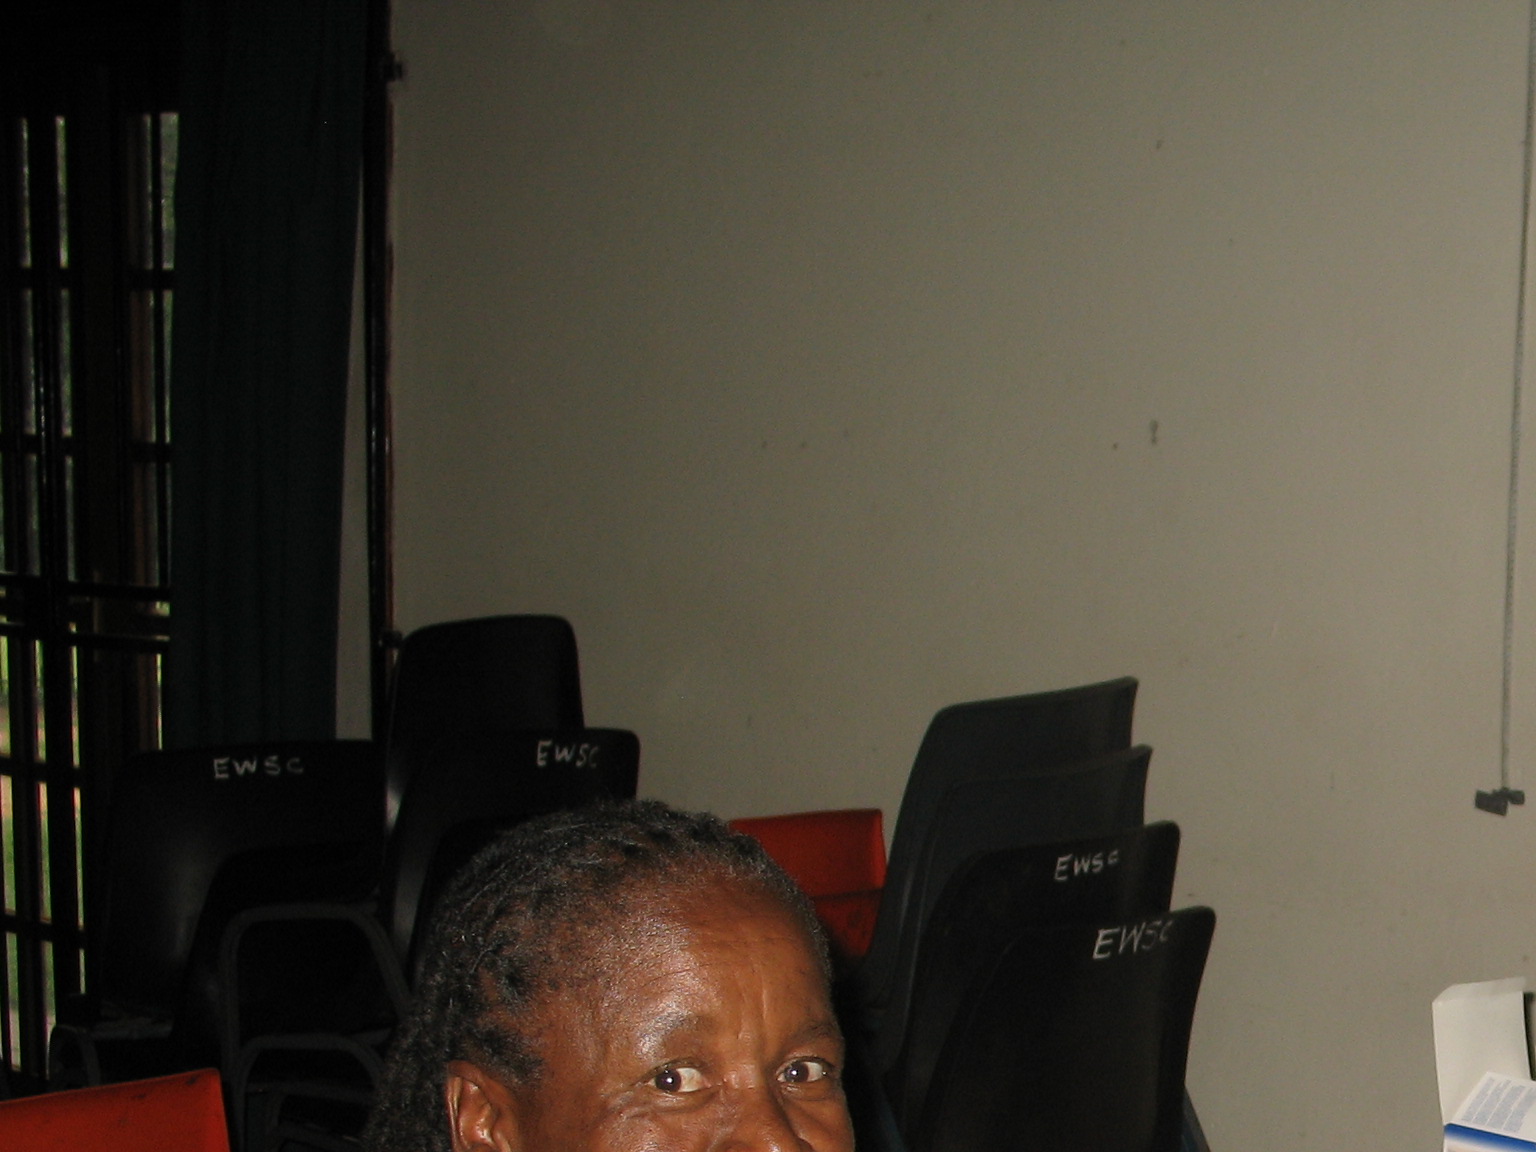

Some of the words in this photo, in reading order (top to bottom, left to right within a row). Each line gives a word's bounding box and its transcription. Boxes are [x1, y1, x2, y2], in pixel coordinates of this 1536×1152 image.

[212, 754, 305, 780] EWSC
[537, 738, 598, 768] EWSC
[1092, 920, 1173, 961] EWSC
